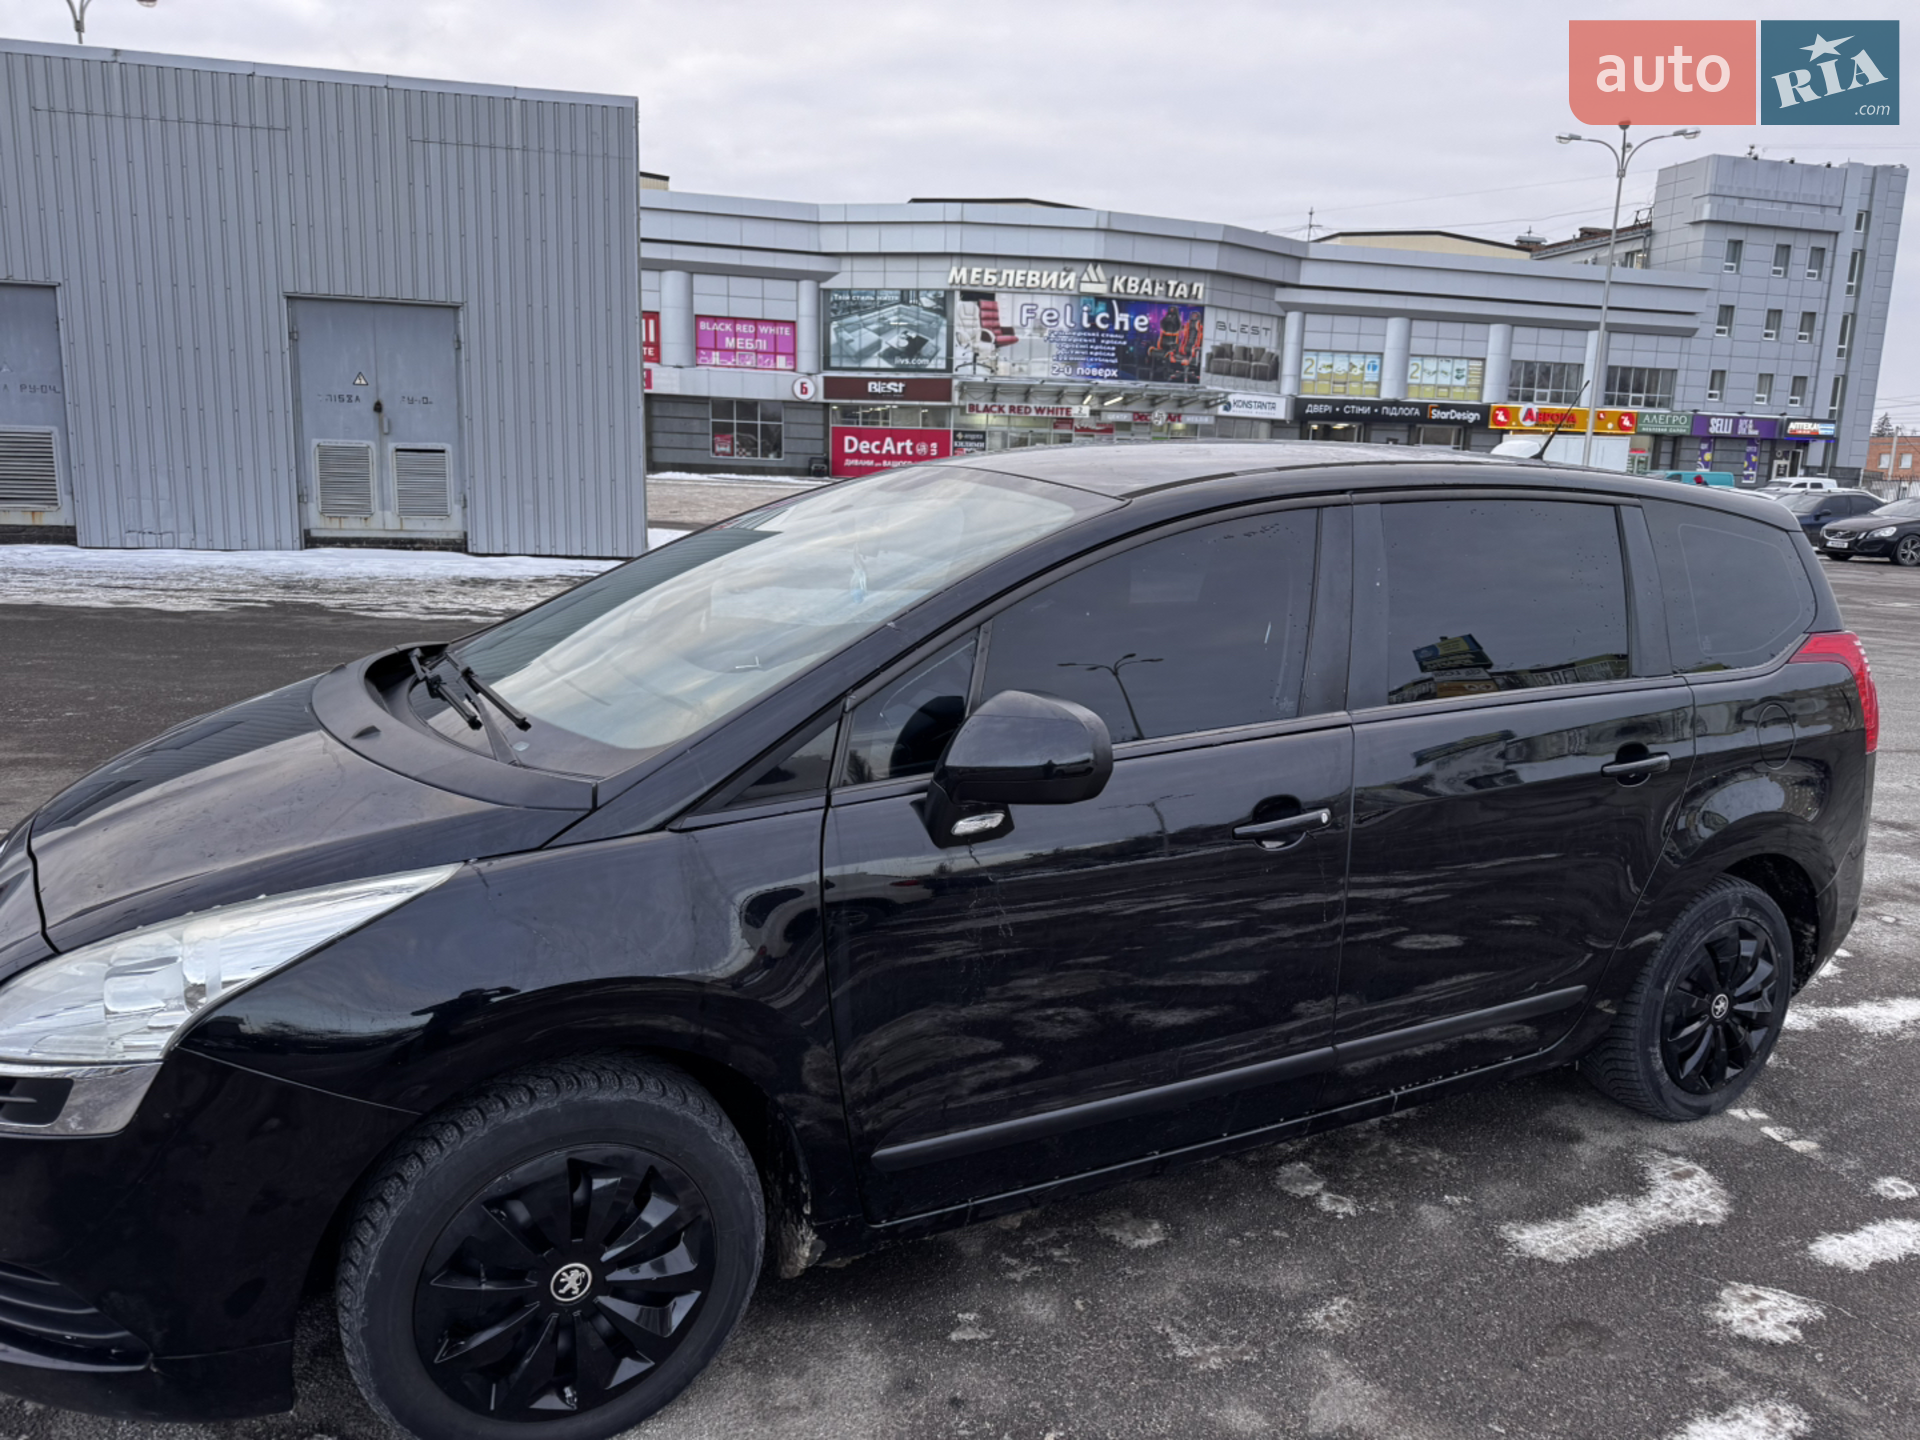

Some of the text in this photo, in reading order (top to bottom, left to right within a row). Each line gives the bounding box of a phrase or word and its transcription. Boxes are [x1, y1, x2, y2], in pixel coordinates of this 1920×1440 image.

[948, 266, 1077, 291] МЕБЛЕВИЙ
[1019, 299, 1150, 332] Feliche
[700, 321, 791, 336] BLACK RED WHITE
[1215, 320, 1272, 337] BLEST
[724, 336, 768, 351] МЕБЛІ
[1076, 366, 1119, 378] поверх
[1303, 357, 1316, 376] 2
[1409, 362, 1421, 380] 2
[968, 403, 1006, 414] BLACK
[1008, 405, 1032, 415] RED
[1034, 406, 1072, 417] WHITE
[1305, 403, 1420, 417] ДВЕРІ СТІНИ ПІДЛОГА
[1431, 408, 1481, 423] StarDesign
[1642, 414, 1688, 425] АЛЕГРО
[843, 435, 914, 456] DecArt
